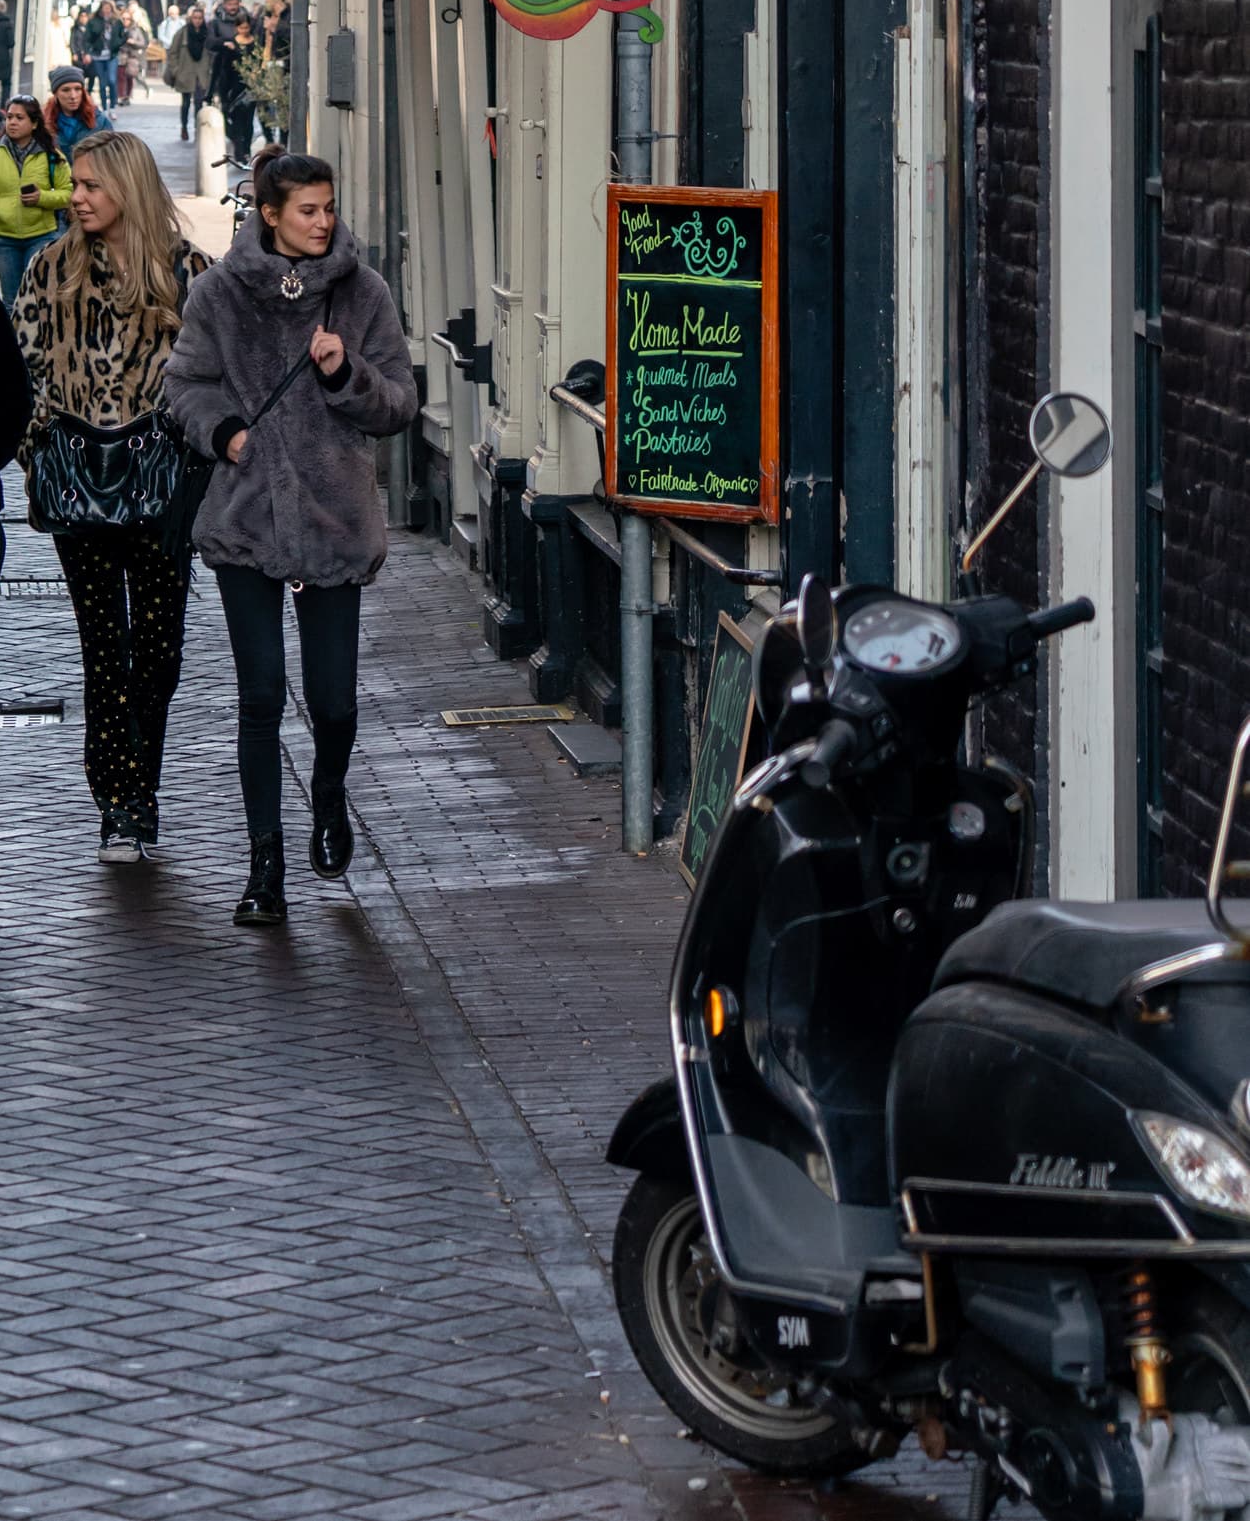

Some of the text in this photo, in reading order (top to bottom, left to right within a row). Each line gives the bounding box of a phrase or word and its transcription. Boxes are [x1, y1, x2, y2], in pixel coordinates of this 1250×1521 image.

[626, 288, 742, 351] Home Made
[692, 361, 737, 389] Meals
[777, 1315, 810, 1349] SYM
